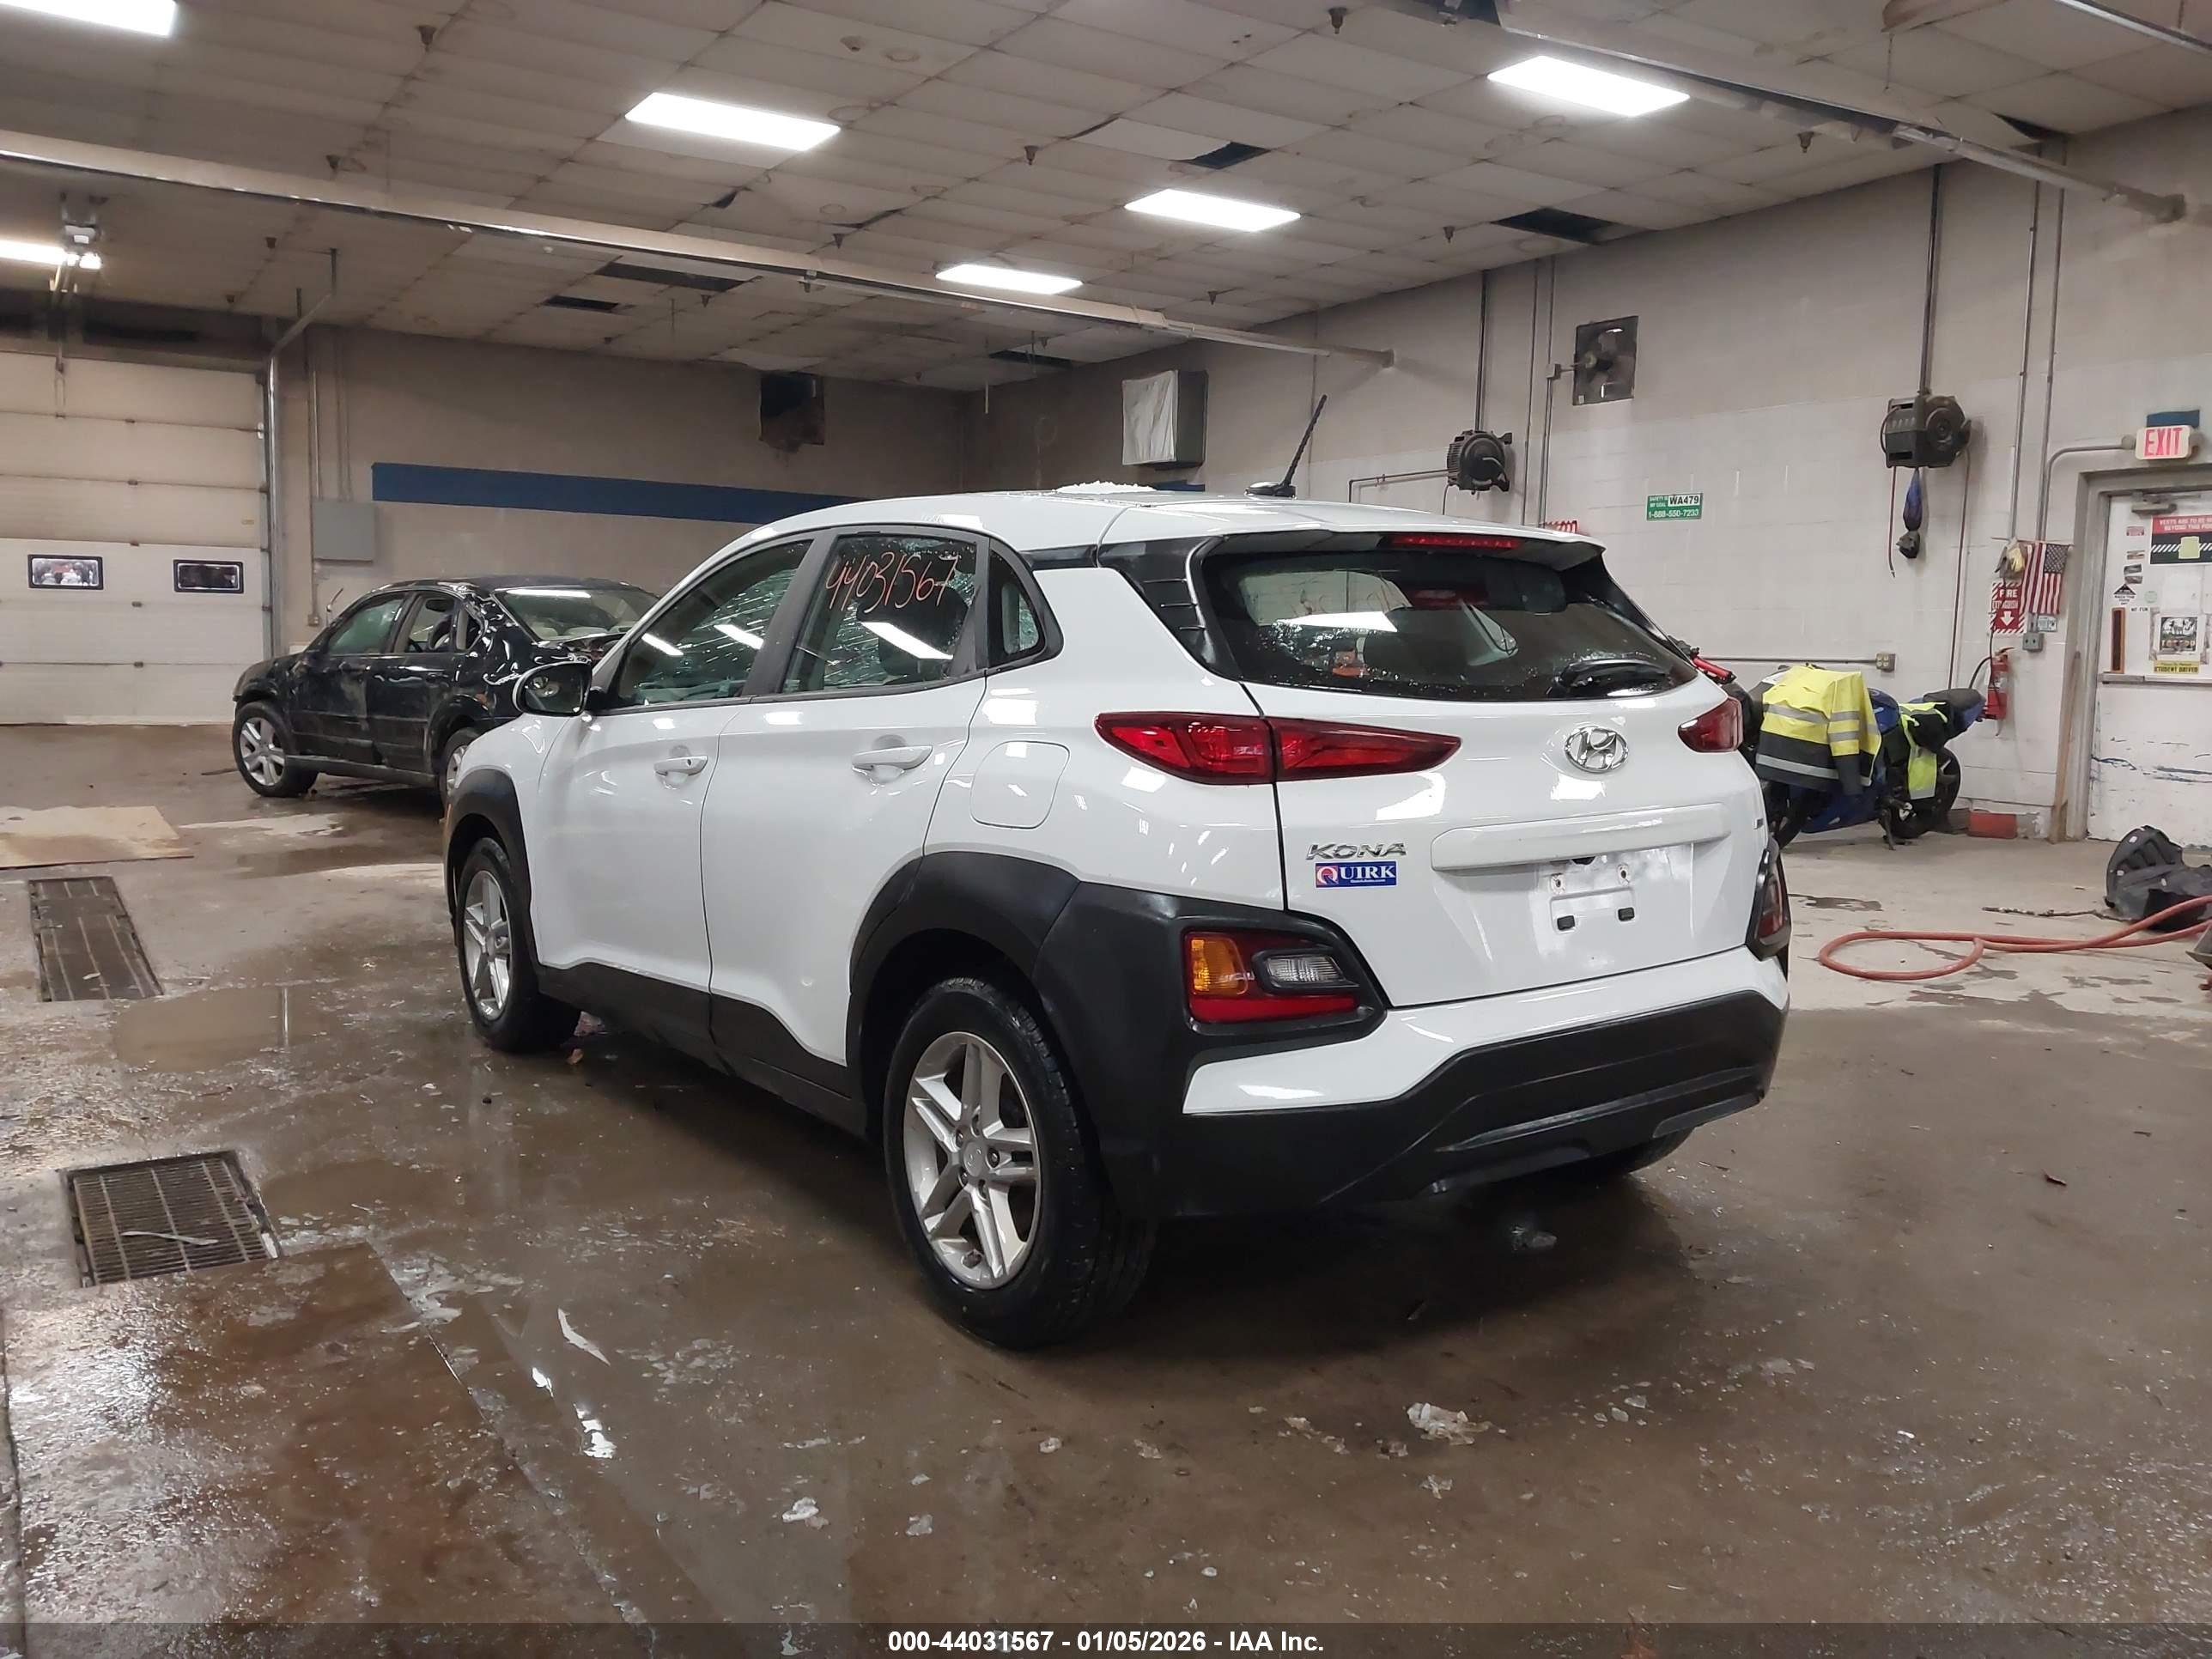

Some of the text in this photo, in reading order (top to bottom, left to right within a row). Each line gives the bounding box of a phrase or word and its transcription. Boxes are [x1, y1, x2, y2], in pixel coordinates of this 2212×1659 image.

[2144, 428, 2183, 456] EXIT
[1669, 495, 1699, 505] WA479
[825, 551, 960, 613] 44031567
[1999, 589, 2018, 598] FRE
[1305, 842, 1407, 860] KONA
[1316, 865, 1396, 885] QUIRK
